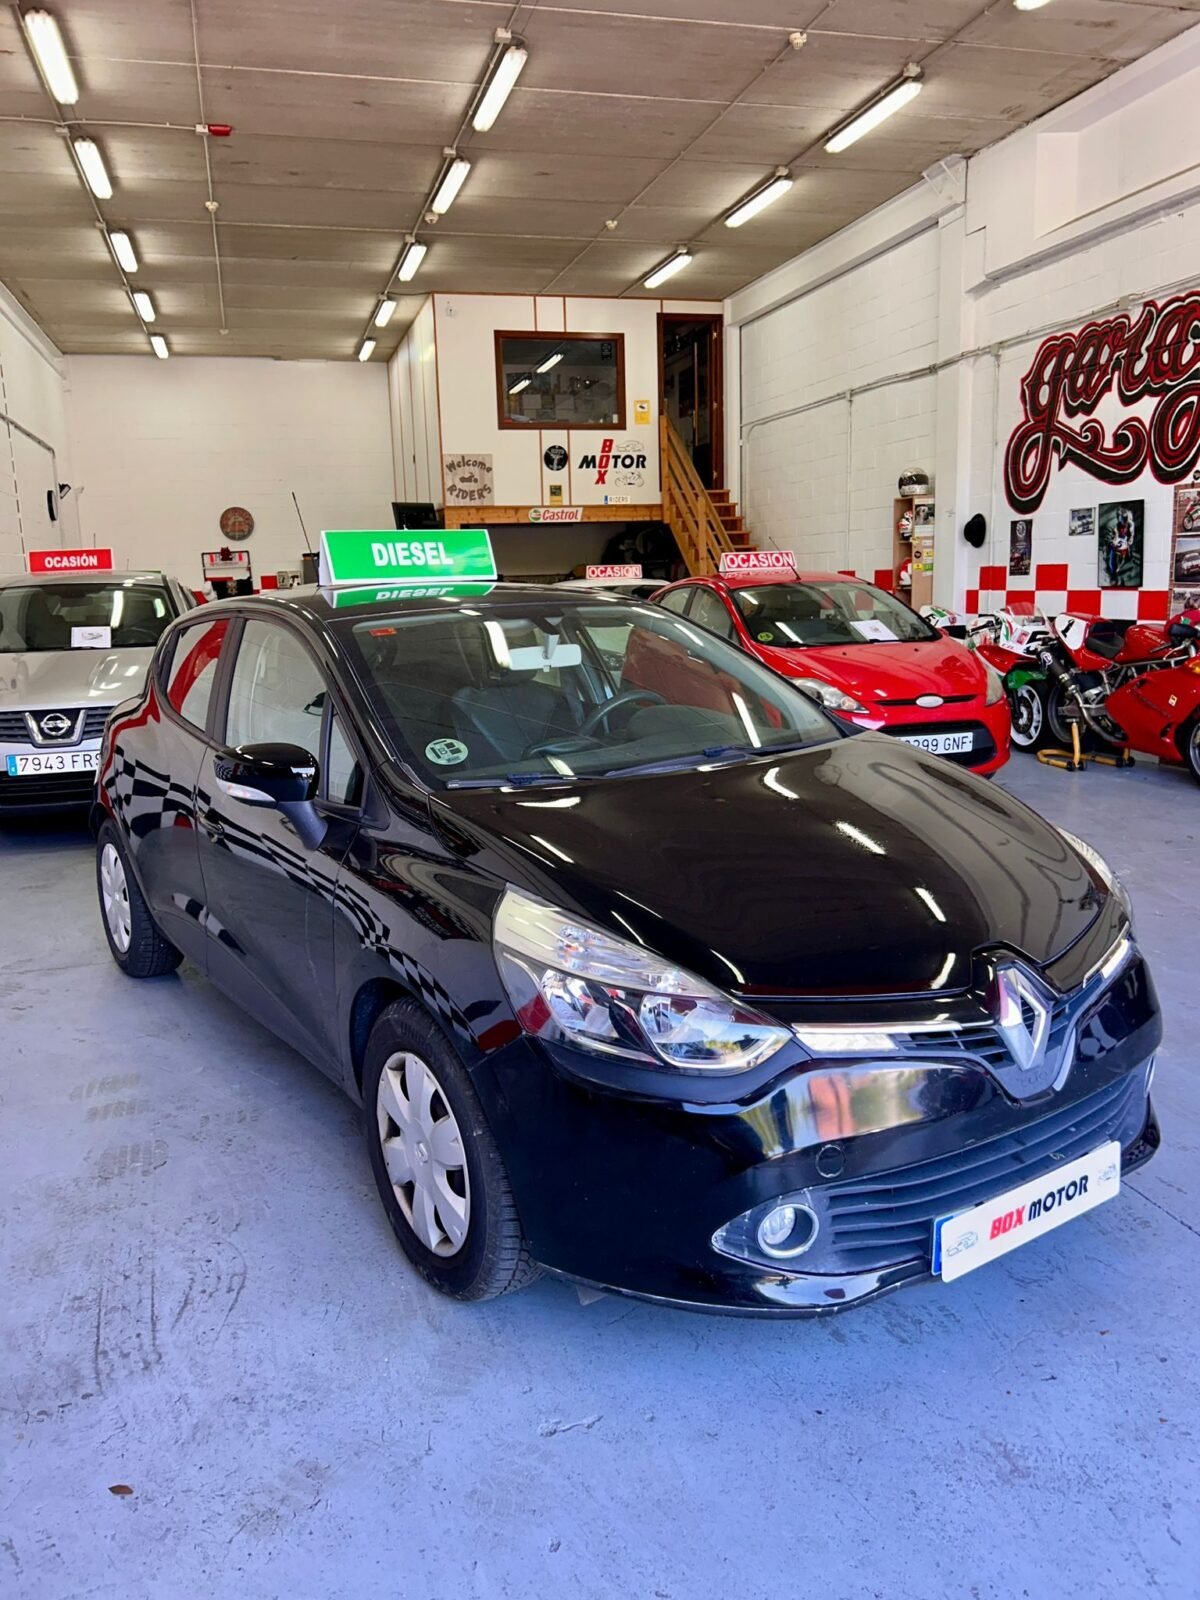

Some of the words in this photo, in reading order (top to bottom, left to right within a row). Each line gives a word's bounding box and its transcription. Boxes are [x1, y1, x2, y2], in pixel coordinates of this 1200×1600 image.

[445, 455, 493, 473] Welcome
[578, 454, 647, 469] MOTOR
[447, 483, 492, 501] RIDERS
[543, 509, 579, 521] Castrol
[44, 555, 98, 568] OCASIÓN
[370, 541, 454, 567] DIESEL
[943, 735, 969, 751] GNF
[19, 756, 65, 772] 7943
[989, 1205, 1025, 1240] BOX
[1028, 1174, 1089, 1222] MOTOR
